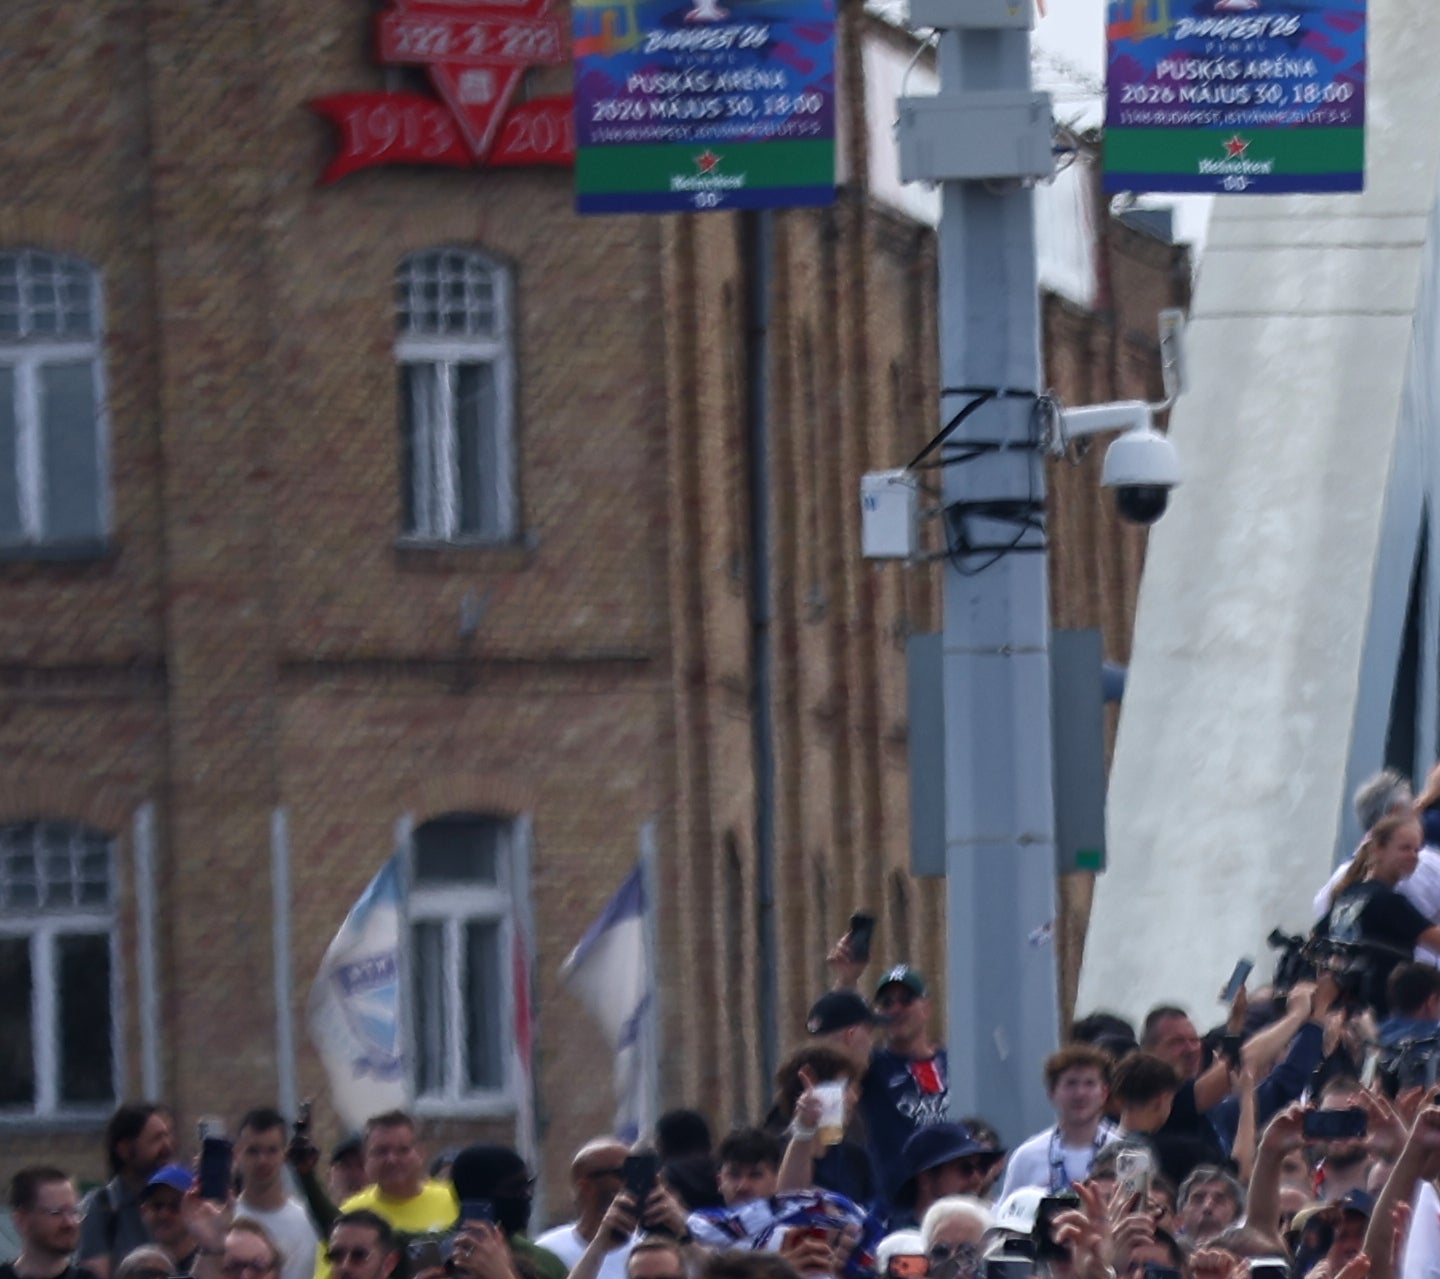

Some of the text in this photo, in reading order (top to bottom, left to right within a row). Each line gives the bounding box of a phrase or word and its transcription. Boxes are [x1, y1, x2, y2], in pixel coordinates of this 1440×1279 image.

[1268, 15, 1301, 37] 26
[627, 65, 713, 94] PUSKÁS
[1156, 54, 1318, 81] PUSKÁS ARÉNA
[592, 99, 647, 121] 2026
[649, 93, 723, 120] MÁJUS
[1120, 80, 1354, 107] 2026 MÁJUS 30, 18:00
[345, 104, 453, 158] 1913
[503, 112, 576, 155] 201
[1199, 158, 1275, 175] Heineken
